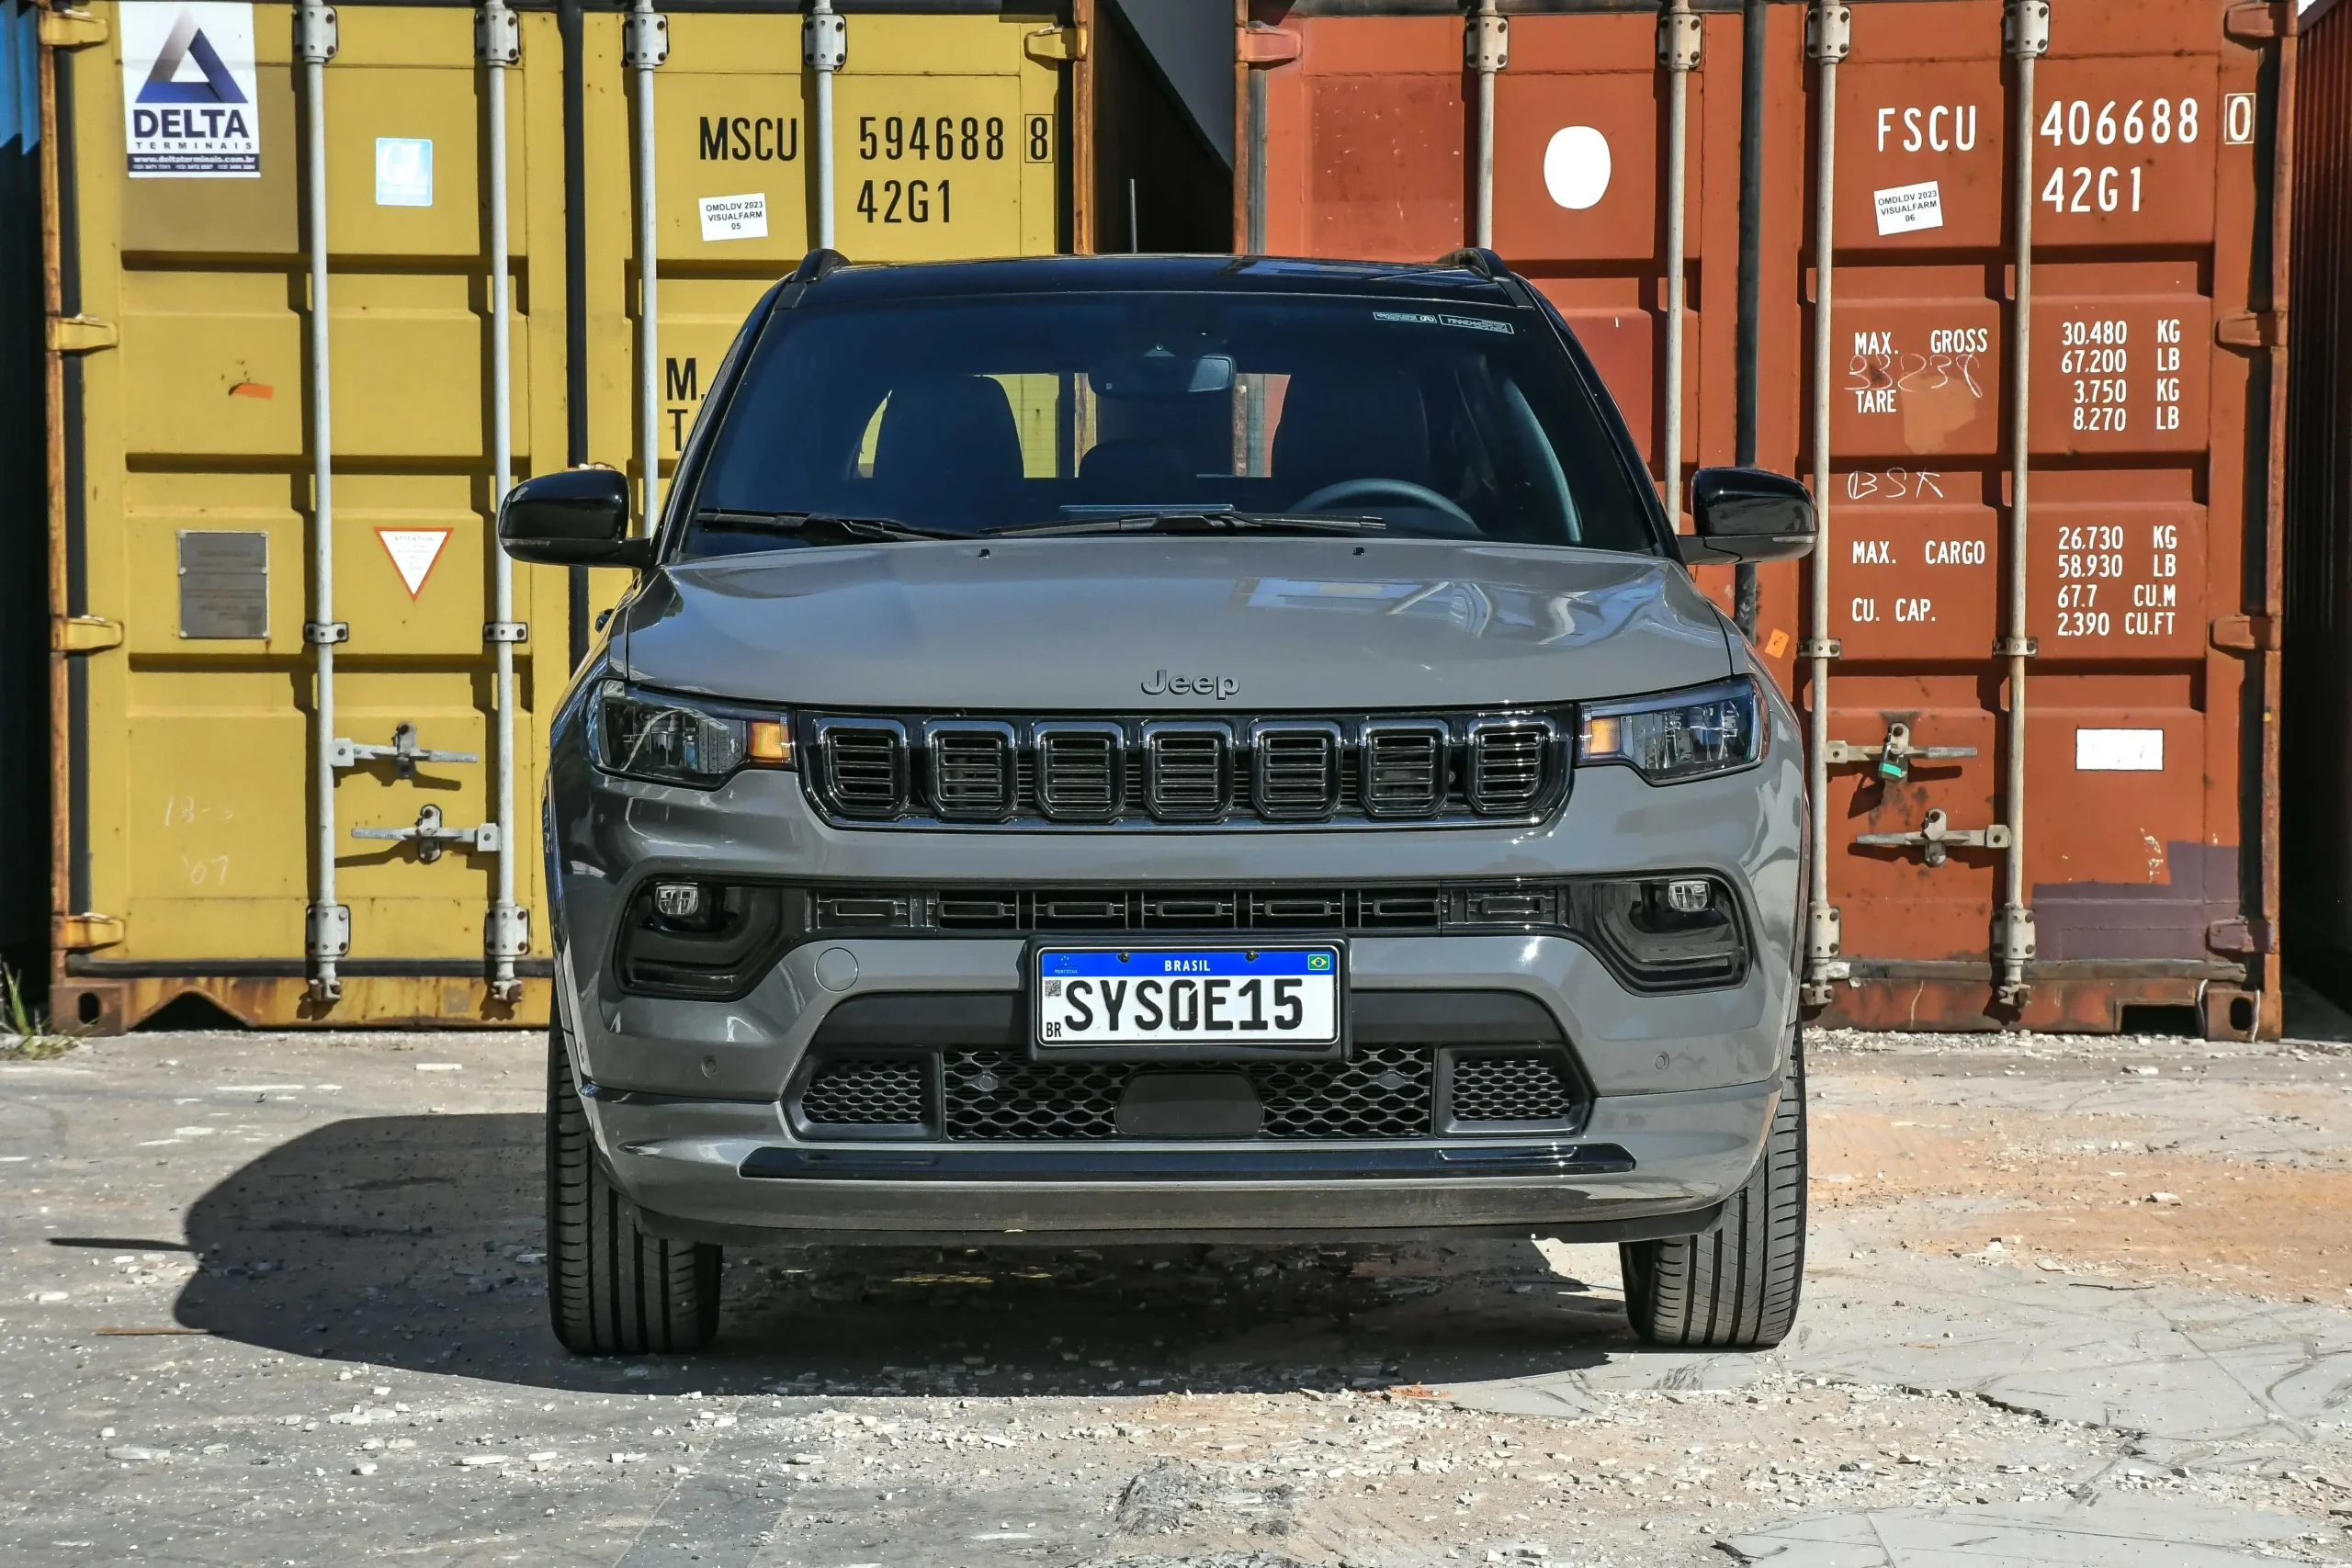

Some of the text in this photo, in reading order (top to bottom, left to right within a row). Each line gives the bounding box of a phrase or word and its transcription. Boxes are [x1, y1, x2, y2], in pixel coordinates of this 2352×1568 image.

[133, 109, 250, 139] DELTA
[1878, 105, 1977, 152] FSCU
[2041, 97, 2199, 147] 406688
[700, 116, 1048, 162] MSCU 594688 8
[1878, 190, 1938, 206] OMDLDV 2023
[2041, 165, 2142, 213] 42G1
[706, 200, 763, 212] OMDLDV 2023
[857, 179, 950, 224] 42G1
[1881, 200, 1938, 216] VISUALFARM
[707, 210, 763, 221] VISUALFARM
[1905, 214, 1916, 222] 06
[1854, 328, 1988, 355] MAX. GROSS
[2157, 319, 2180, 344] KG
[2157, 347, 2180, 372] LB
[1855, 390, 1897, 413] TARE
[2156, 378, 2180, 402] KG
[2156, 406, 2179, 430] LB
[2153, 525, 2177, 550] KG
[1852, 540, 1985, 565] MAX. CARGO
[2153, 554, 2177, 577] LB
[2057, 584, 2177, 608] 67.7 CU.M
[1851, 598, 1936, 622] CU. CAP.
[2124, 611, 2176, 636] CU.FT
[1141, 670, 1240, 700] Jeep
[1165, 960, 1210, 972] BRASIL
[1046, 1021, 1062, 1038] BR
